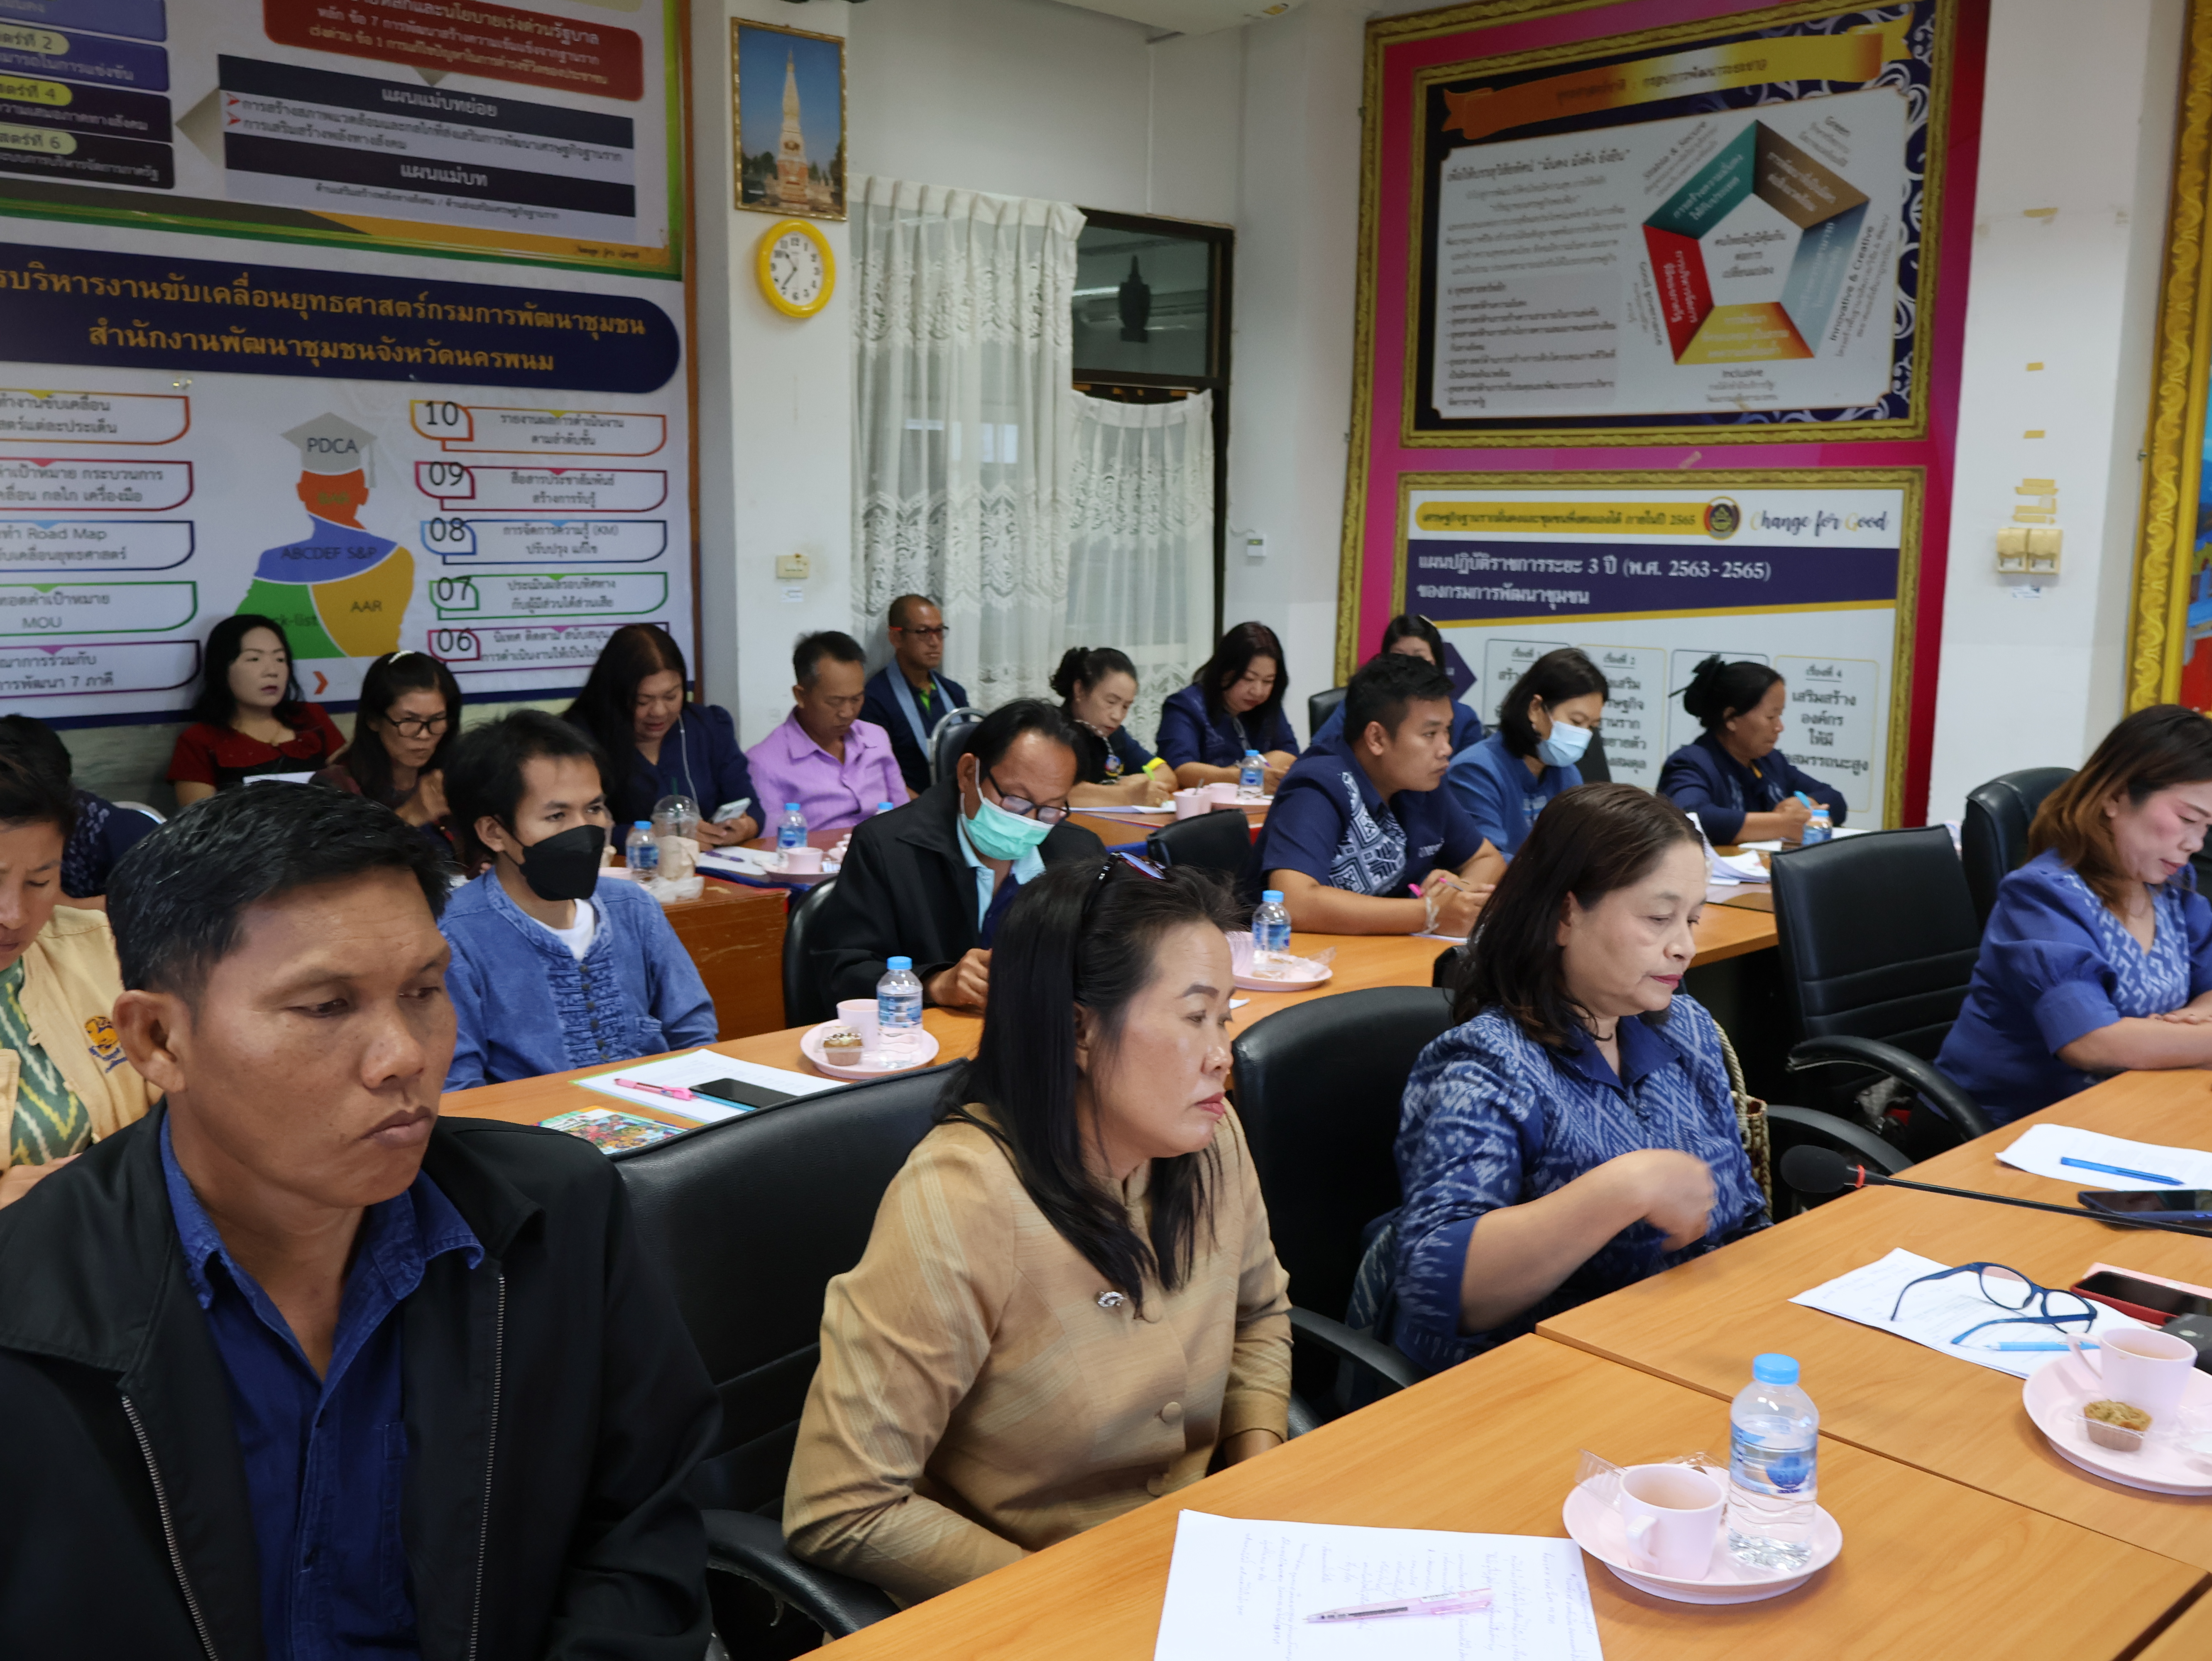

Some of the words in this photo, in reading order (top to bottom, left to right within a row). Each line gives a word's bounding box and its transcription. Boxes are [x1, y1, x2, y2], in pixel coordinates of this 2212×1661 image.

[42, 36, 52, 49] 2
[45, 88, 55, 100] 4
[49, 136, 61, 149] 6
[400, 164, 488, 187] แผนแม่บท
[89, 318, 555, 371] สำนักงานพัฒนาชุมชนจังหวัดนครพนม
[426, 401, 458, 426] 10
[307, 438, 360, 454] PDCA
[428, 461, 465, 486] 09
[1669, 514, 1695, 525] 2565
[1750, 510, 1809, 535] Change
[27, 527, 68, 540] Road
[73, 528, 107, 541] Map
[429, 517, 465, 541] 08
[280, 546, 343, 561] ABCDEF
[1587, 558, 1599, 574] 3
[1603, 555, 1618, 575] ปี
[1622, 557, 1662, 578] (พ.ศ.
[1668, 559, 1772, 582] 2563-2565)
[437, 576, 472, 602] 07
[1416, 582, 1590, 610] ของกรมการพัฒนาชุมชน
[350, 600, 383, 613] AAR
[22, 616, 63, 629] MOU
[437, 627, 472, 652] 06
[71, 676, 80, 687] 7
[1792, 689, 1856, 706] เสริมสร้าง
[1800, 710, 1844, 726] องค์กร
